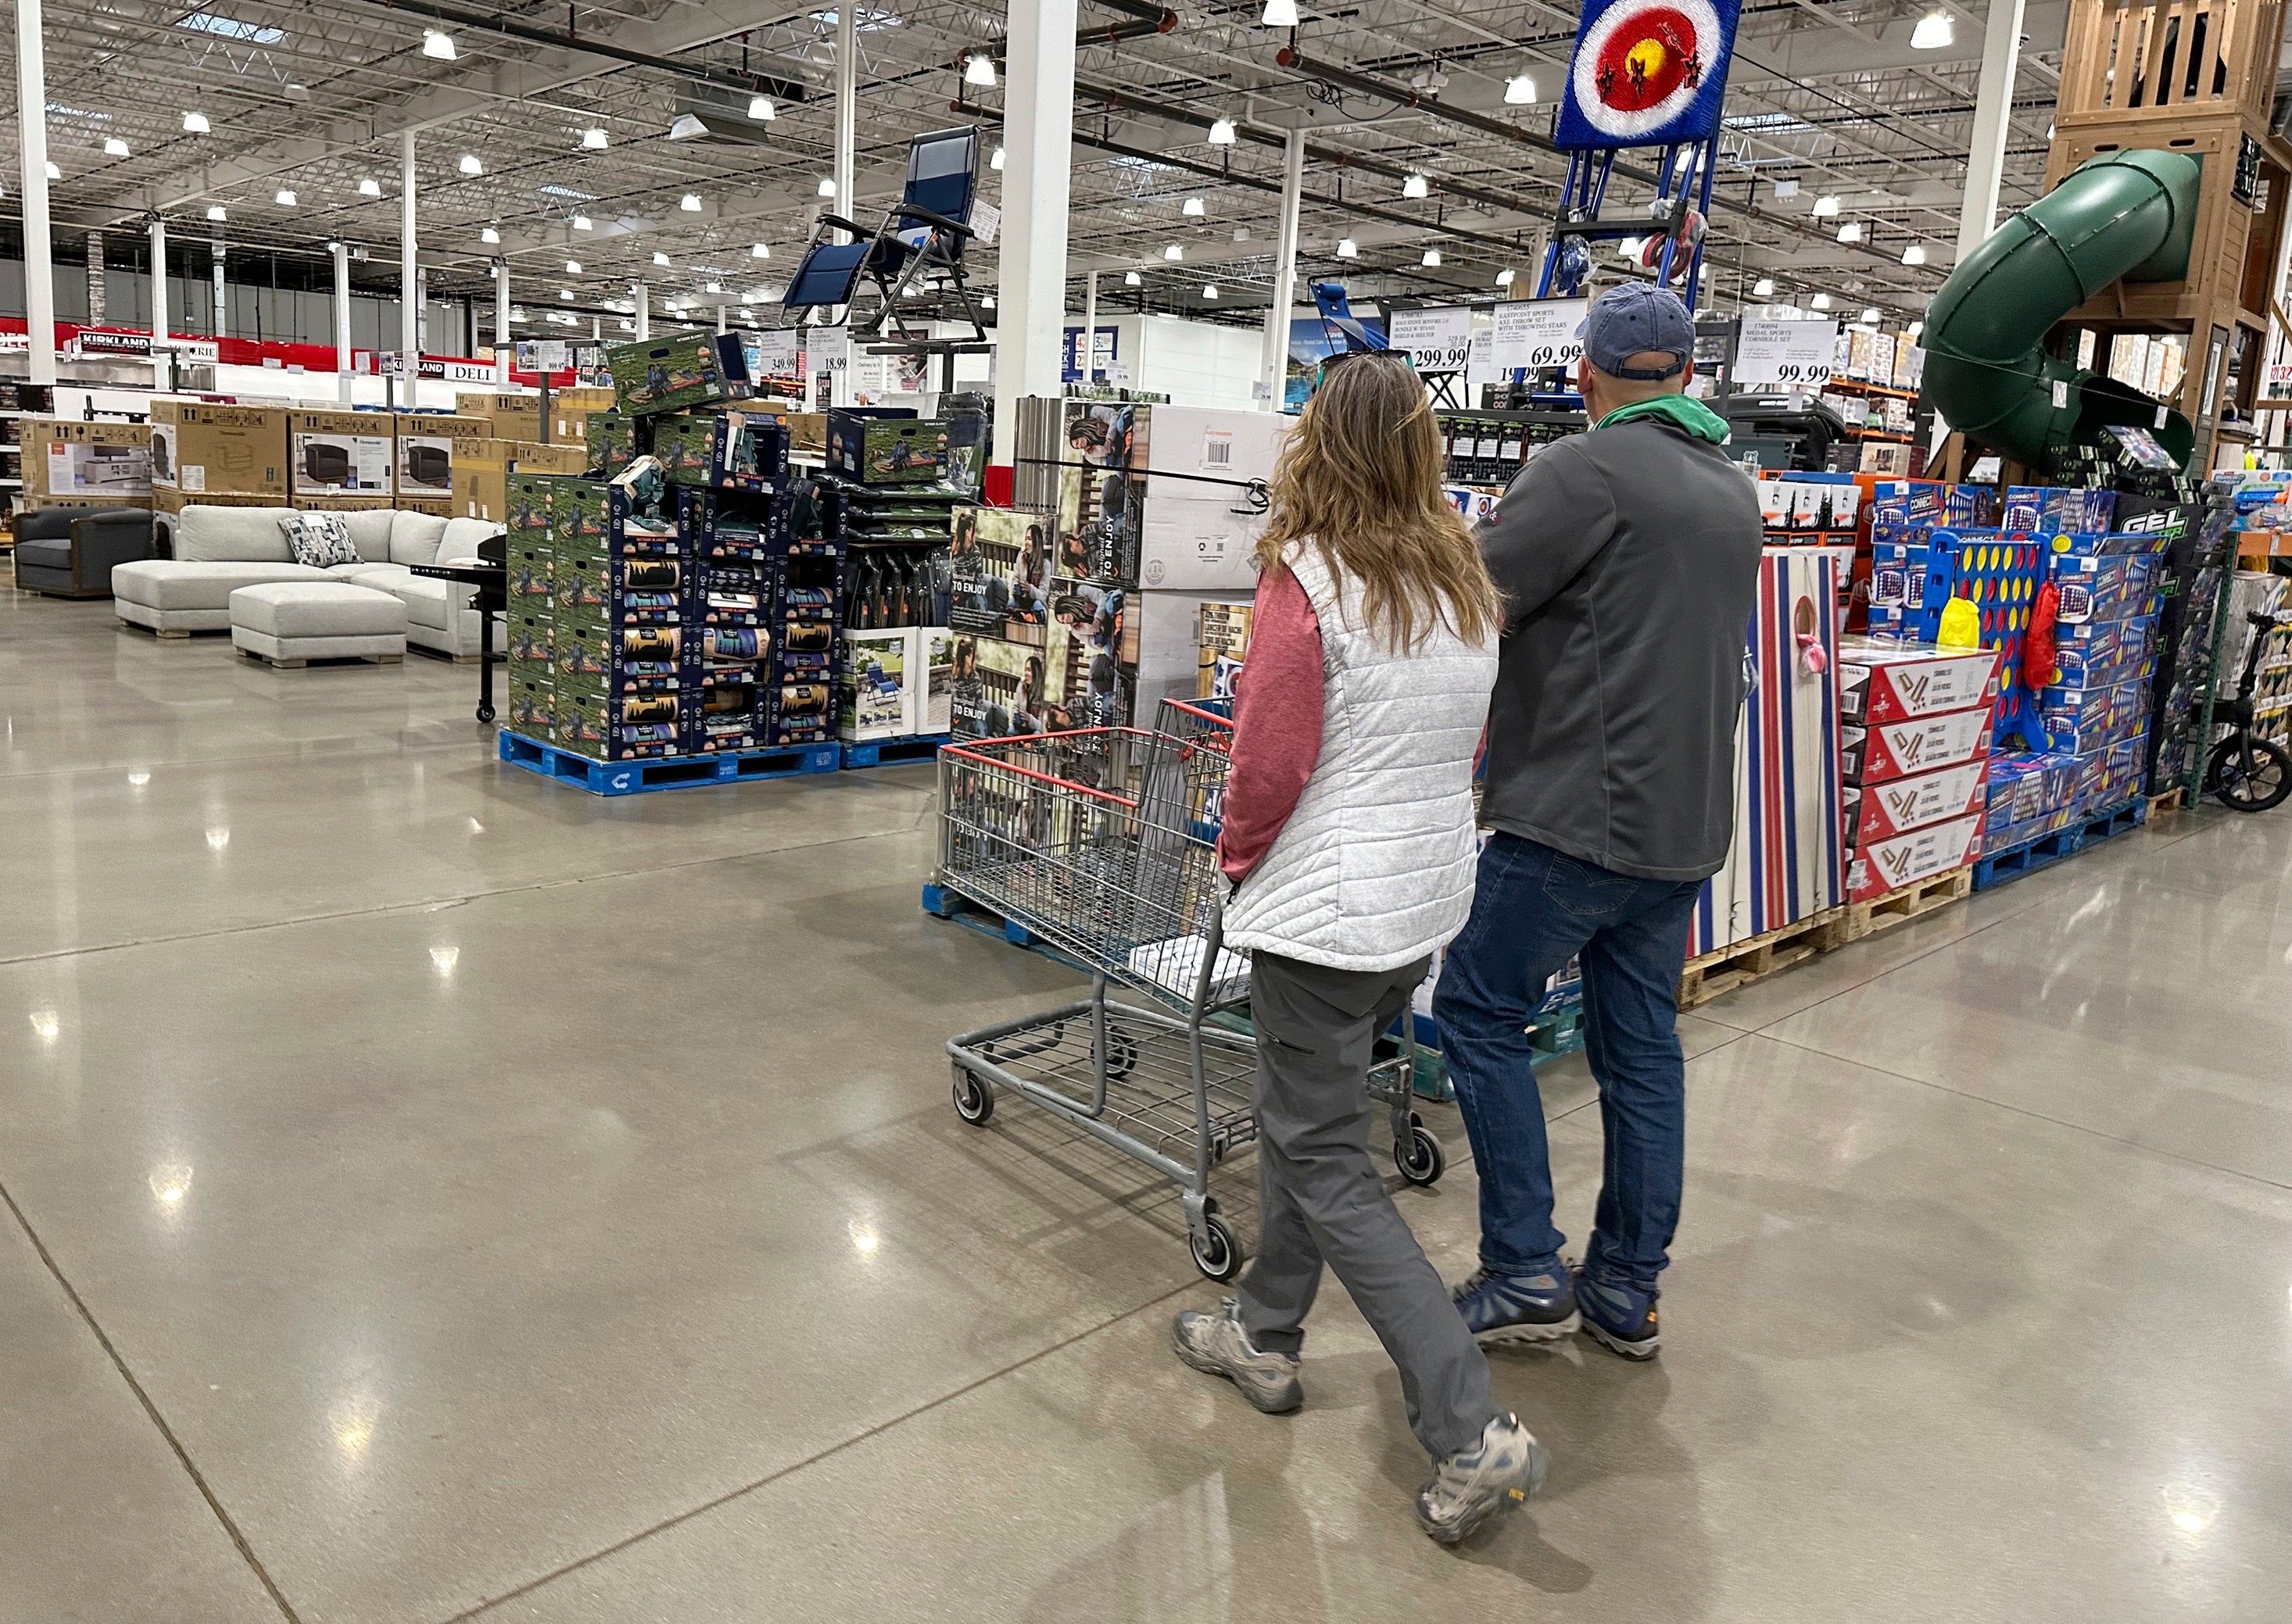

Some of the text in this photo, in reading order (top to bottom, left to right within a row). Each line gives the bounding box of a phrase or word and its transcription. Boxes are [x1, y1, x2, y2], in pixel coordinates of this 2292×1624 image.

[83, 334, 149, 348] KIRKLAND
[1414, 349, 1467, 367] 299.99
[1531, 345, 1583, 366] 69.99
[394, 362, 443, 373] KILAND
[772, 358, 796, 370] 349.99
[825, 357, 847, 370] 18.99
[455, 366, 490, 381] DELI
[1777, 364, 1829, 383] 99.99
[1910, 495, 1933, 510] CONNECT
[2122, 510, 2186, 534] GEL
[1104, 515, 1114, 577] TO ENJOY
[952, 581, 987, 596] TO ENJOY
[953, 703, 987, 721] TO ENJOY
